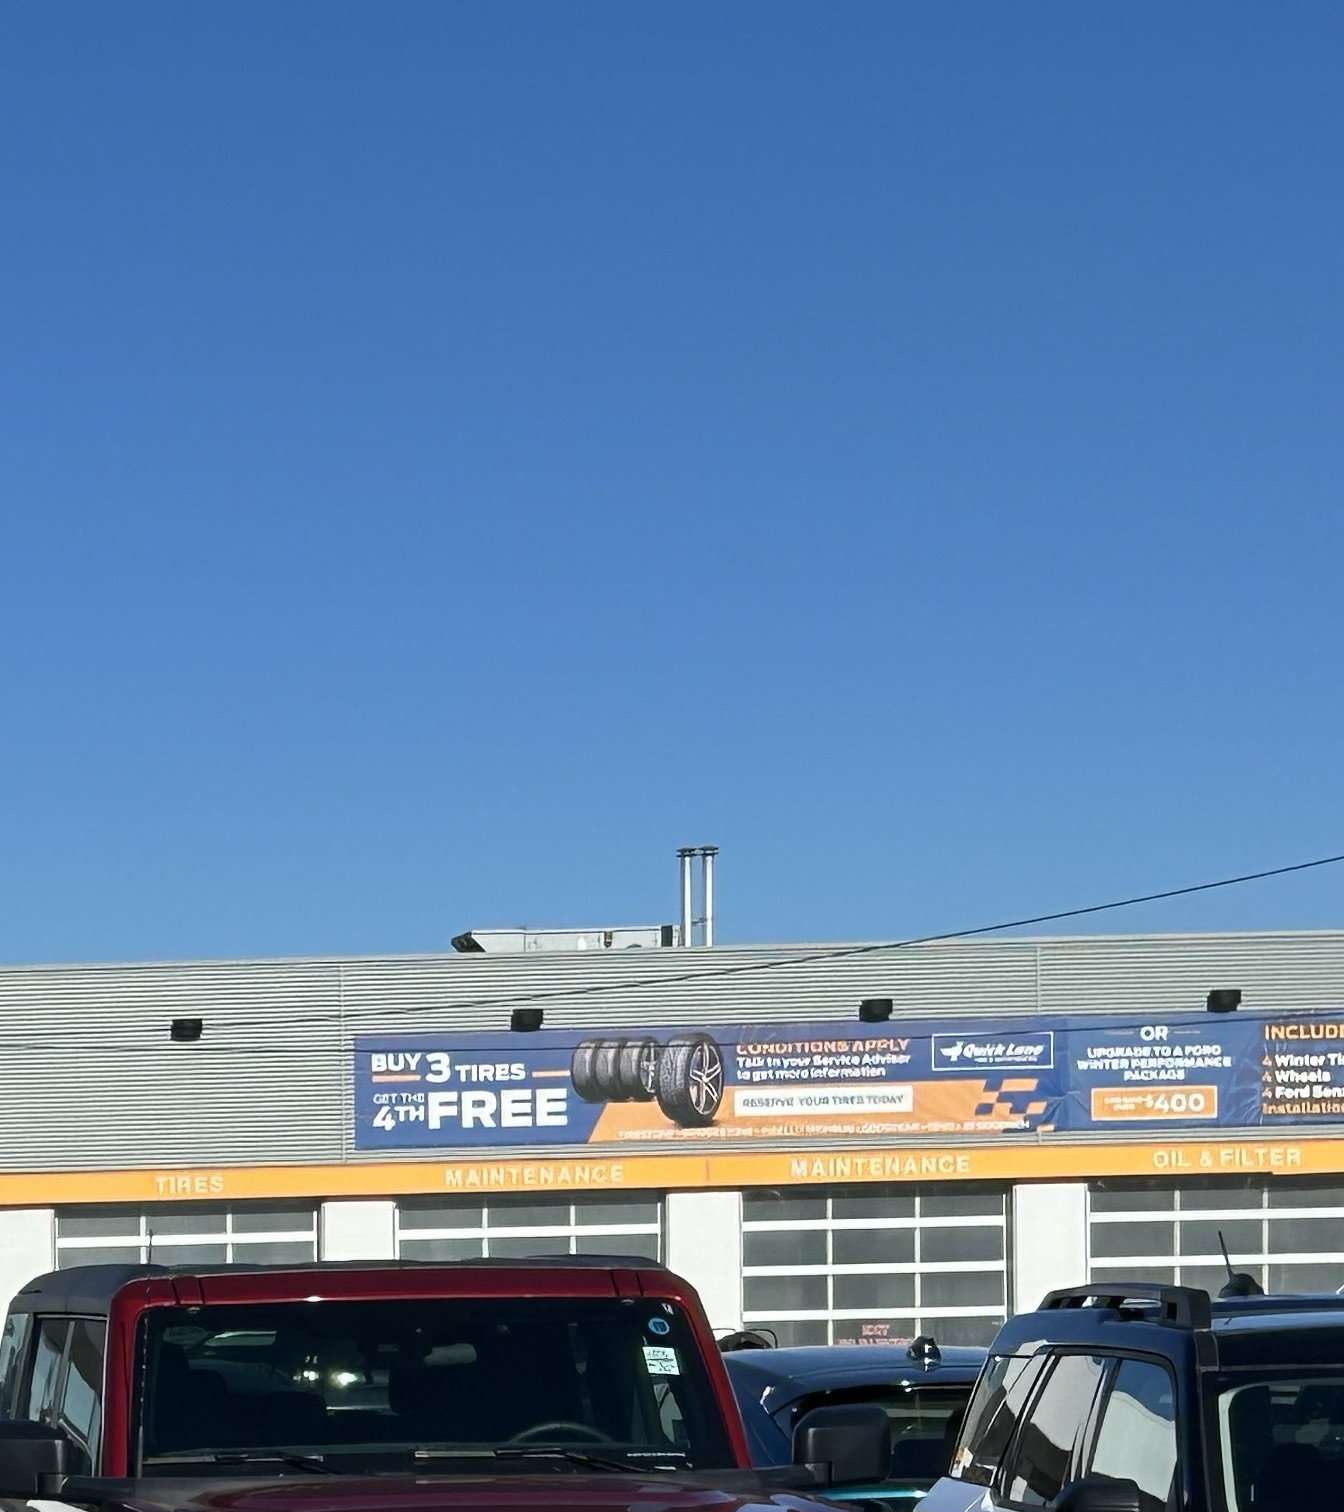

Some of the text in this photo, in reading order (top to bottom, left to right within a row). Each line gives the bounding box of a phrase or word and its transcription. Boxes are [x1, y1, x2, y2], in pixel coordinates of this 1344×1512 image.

[1140, 1026, 1168, 1041] OR
[736, 1038, 910, 1055] CONDITIONS APPLY
[963, 1043, 1044, 1058] Quick Lane
[1087, 1046, 1151, 1059] UPGRADE
[1152, 1046, 1171, 1057] TO
[1185, 1045, 1222, 1056] FORD
[371, 1052, 526, 1084] BUY 3 TIRES
[736, 1056, 764, 1068] Talk
[782, 1056, 811, 1069] your
[812, 1054, 859, 1067] Service
[1077, 1056, 1232, 1070] WINTER PERFORMANCE
[1275, 1054, 1326, 1067] Winter
[776, 1068, 810, 1080] more
[811, 1066, 886, 1079] information
[1124, 1069, 1185, 1081] PACKAGE
[1275, 1069, 1331, 1083] Wheels
[1275, 1084, 1311, 1099] Ford
[742, 1094, 905, 1108] RESERVE YOUR TIRES TODAY
[427, 1088, 568, 1130] FREE
[372, 1105, 425, 1132] 4TH
[1152, 1148, 1303, 1168] OIL & FILTER
[791, 1156, 971, 1176] MAINTENANCE
[444, 1165, 625, 1188] MAINTENANCE
[155, 1176, 224, 1195] TIRES
